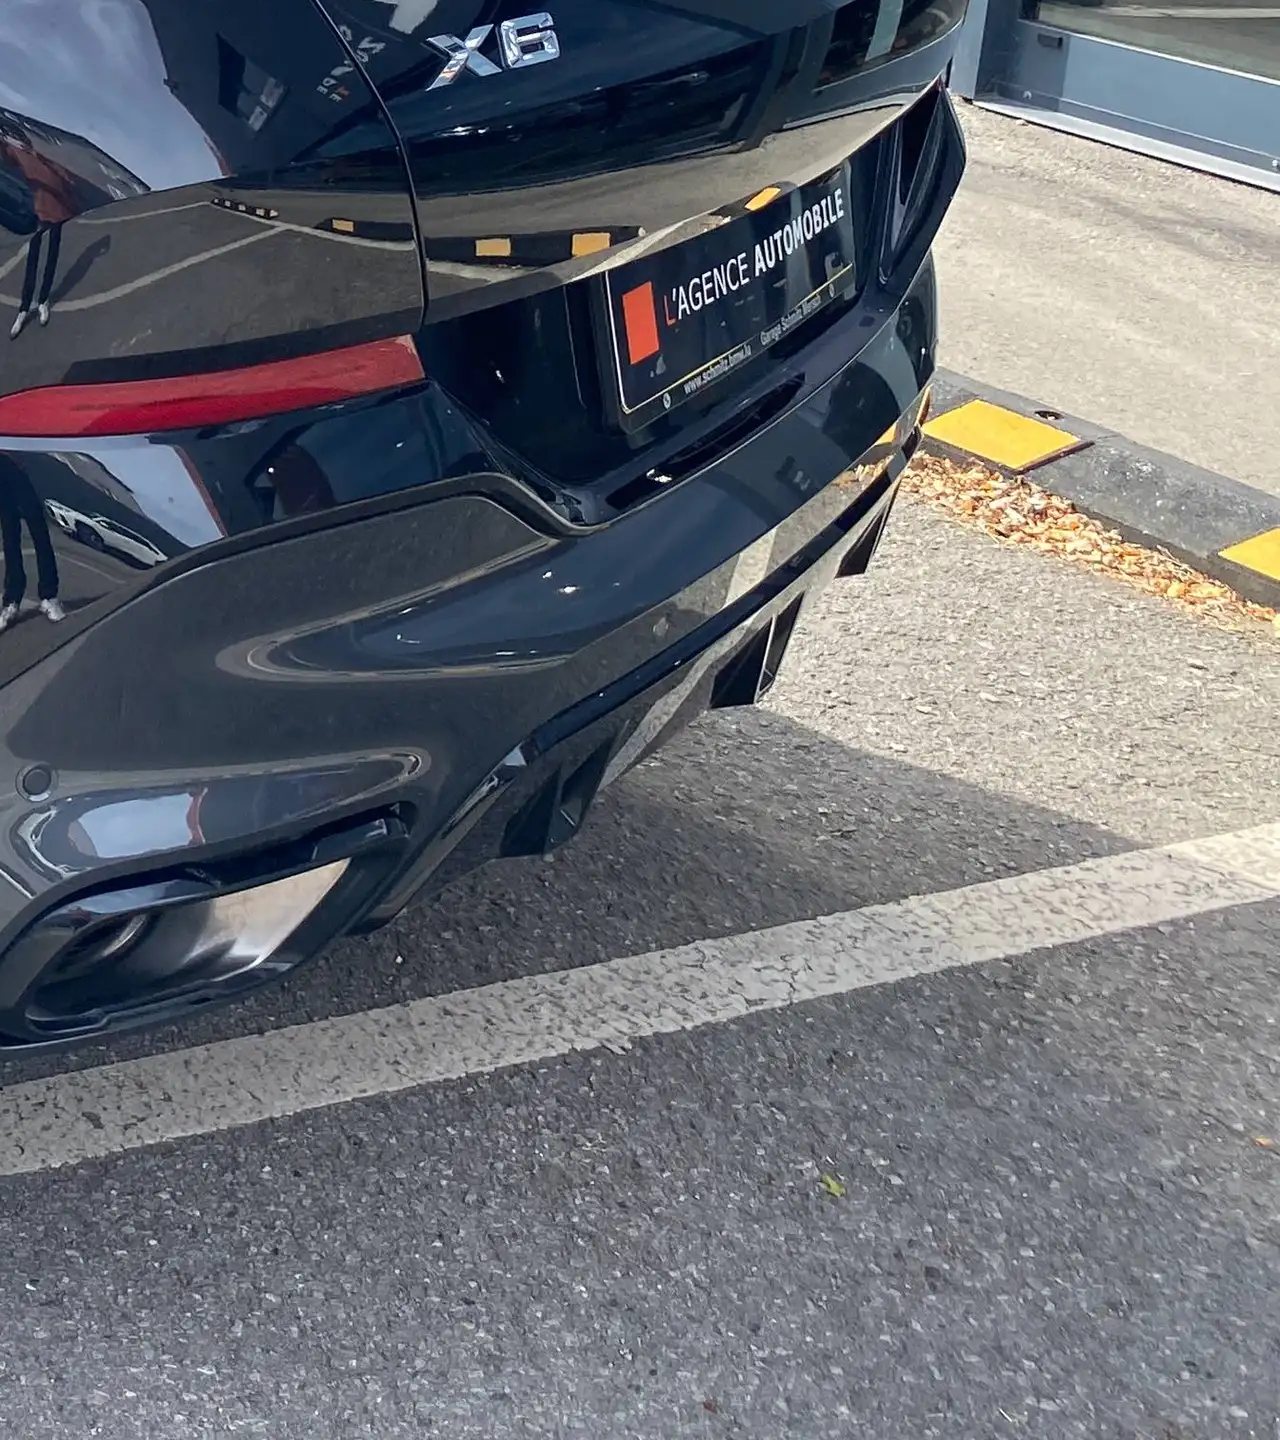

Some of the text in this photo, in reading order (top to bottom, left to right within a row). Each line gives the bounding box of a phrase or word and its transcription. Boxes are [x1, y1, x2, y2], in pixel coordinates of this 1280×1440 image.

[425, 12, 561, 92] X6
[663, 187, 845, 327] L'AGENCE AUTOMOBILE
